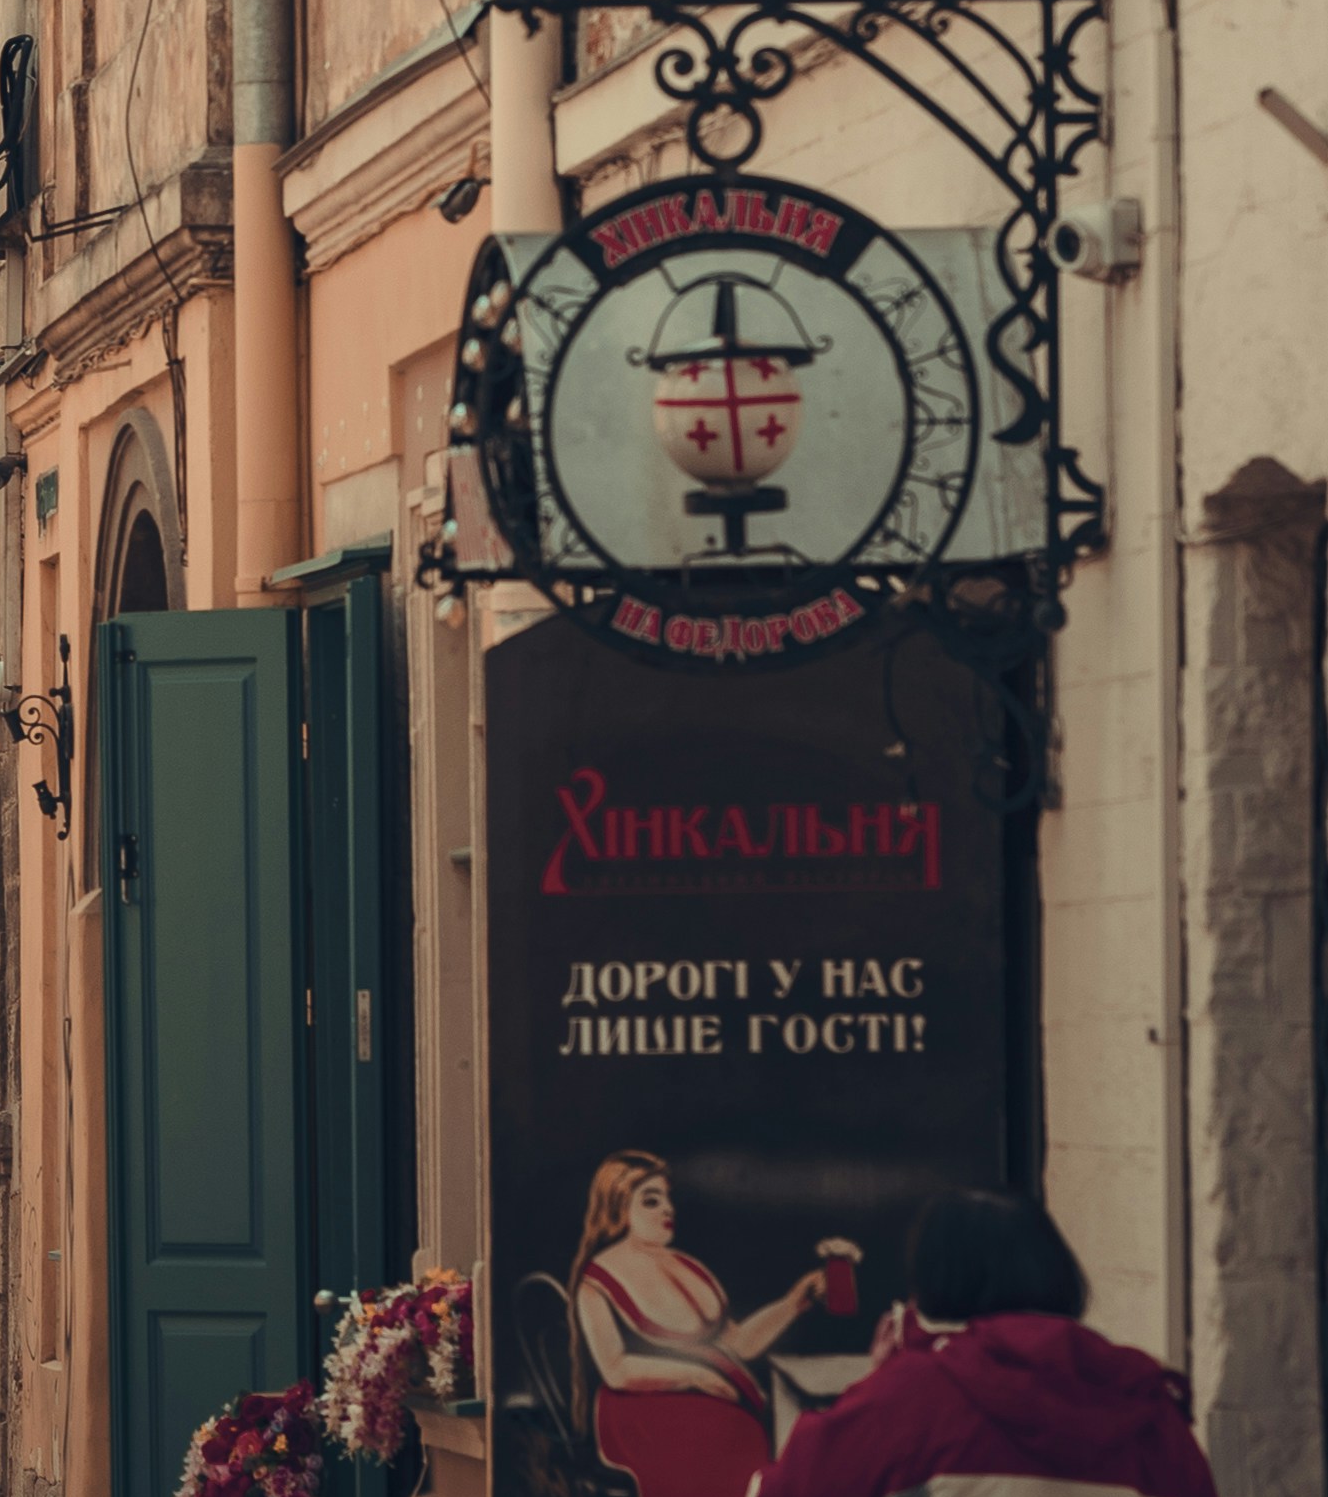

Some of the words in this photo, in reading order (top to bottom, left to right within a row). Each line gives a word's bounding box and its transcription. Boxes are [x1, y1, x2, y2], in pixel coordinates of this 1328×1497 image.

[590, 188, 843, 268] ХІНКАЛЬНЯ
[611, 595, 661, 645] НА
[541, 767, 941, 894] ХІНКАЛЬНЯ
[562, 961, 749, 1008] ДОРОГІ
[766, 960, 802, 999] У
[821, 958, 925, 999] НАС
[559, 1014, 724, 1056] ЛИШЕ
[747, 1013, 927, 1055] ГОСТІ!
